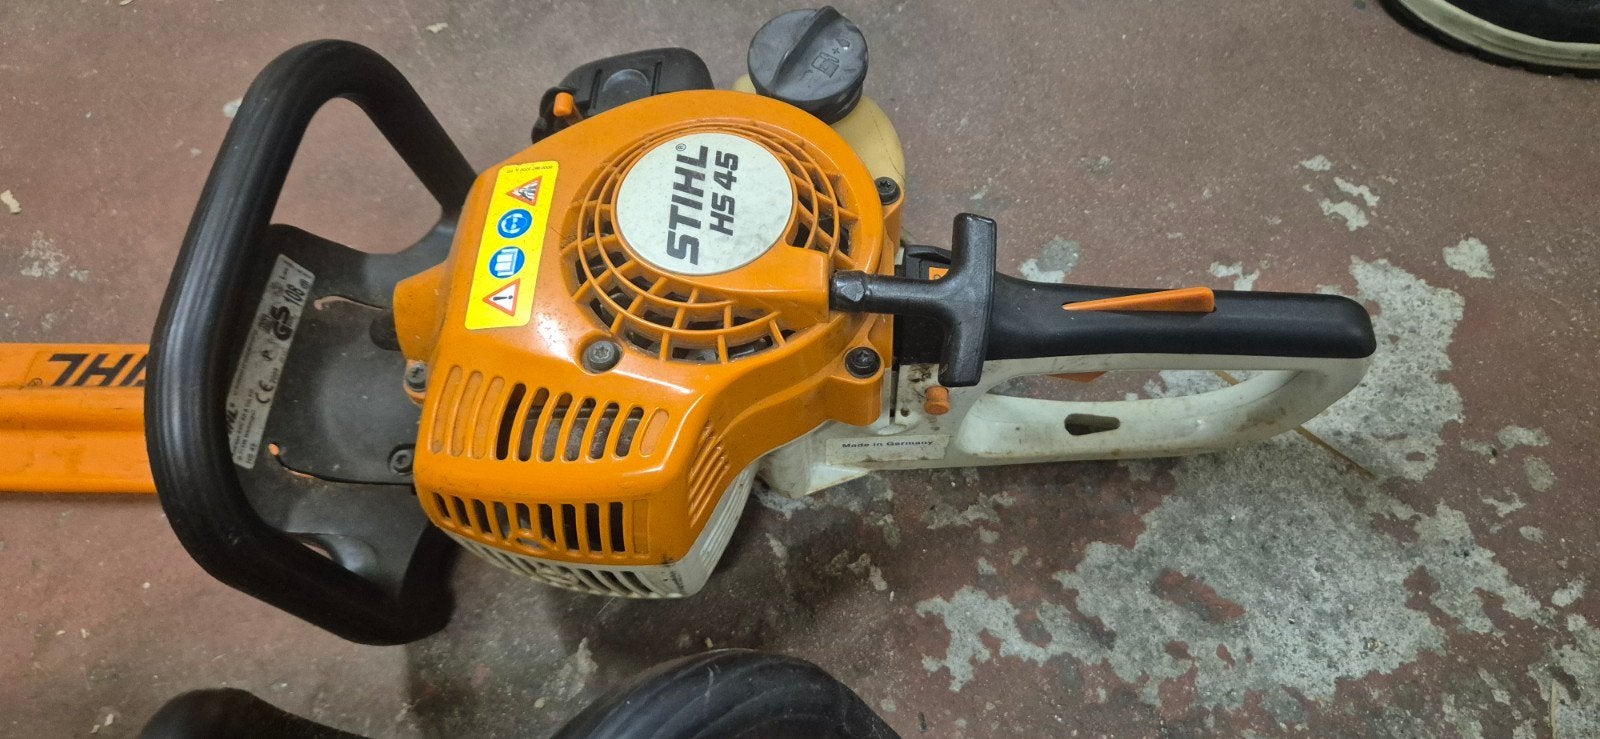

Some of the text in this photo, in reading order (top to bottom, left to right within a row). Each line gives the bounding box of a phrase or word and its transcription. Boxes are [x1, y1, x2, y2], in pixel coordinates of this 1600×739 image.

[667, 145, 708, 265] STIHL
[709, 151, 738, 236] HS 45
[283, 284, 305, 306] 108
[48, 353, 148, 387] IHL
